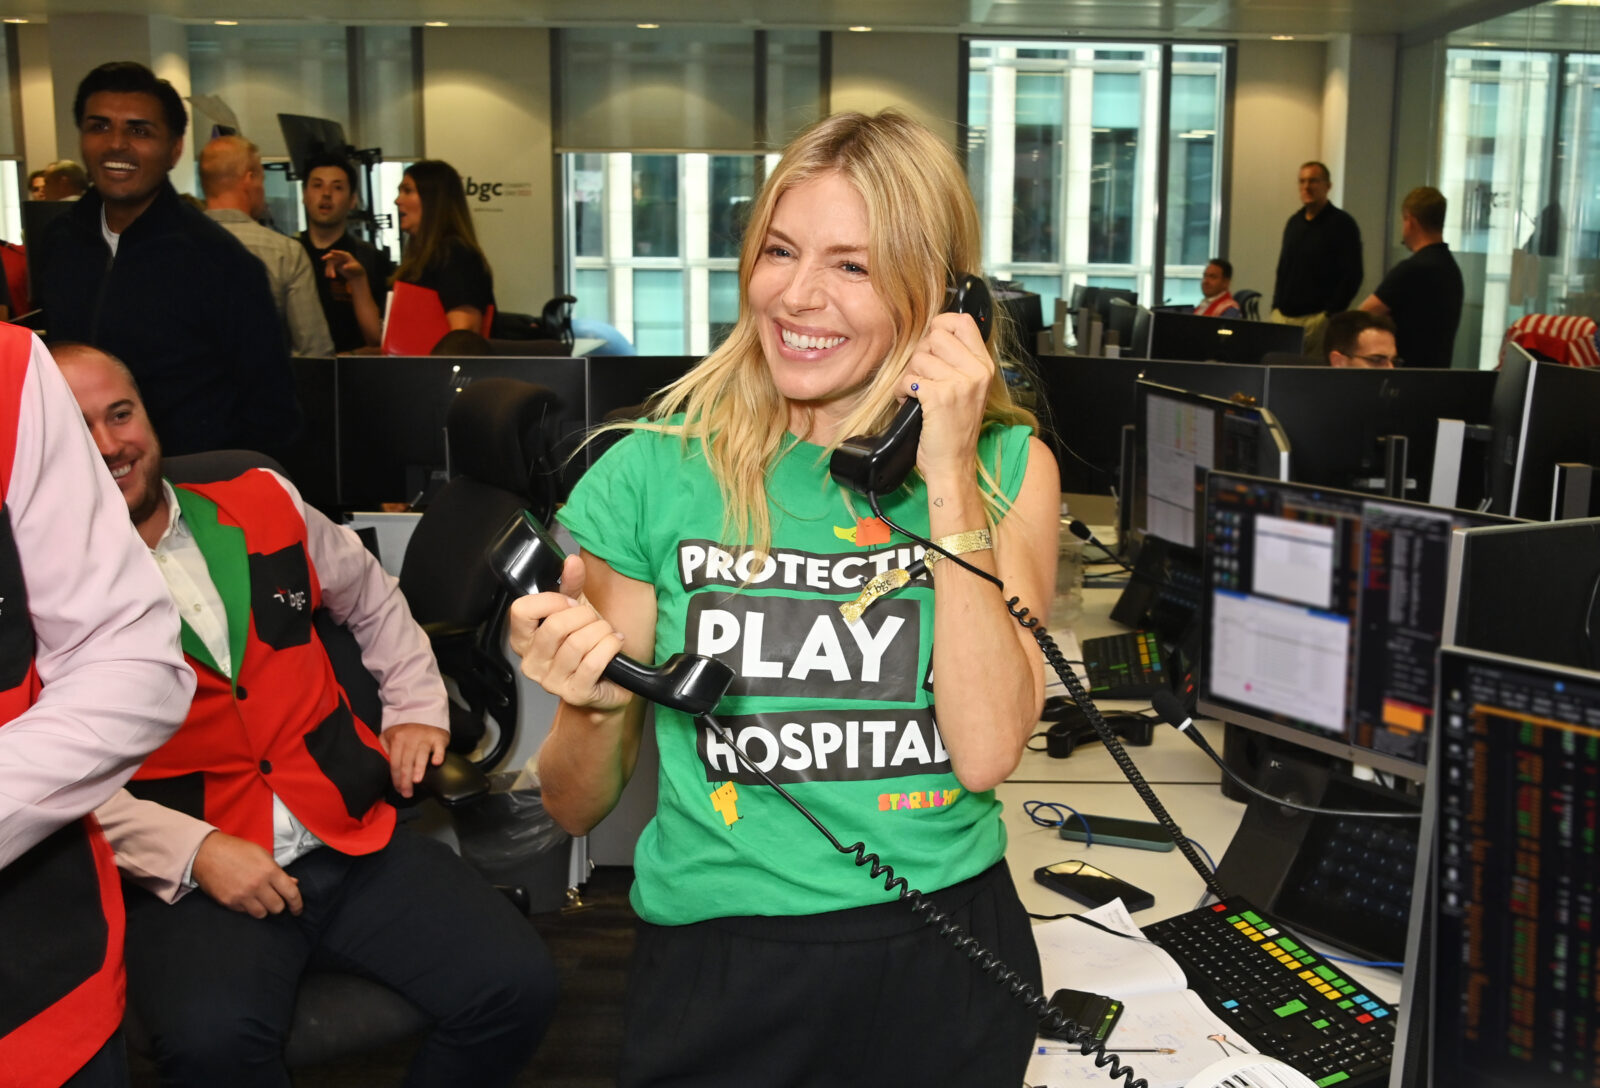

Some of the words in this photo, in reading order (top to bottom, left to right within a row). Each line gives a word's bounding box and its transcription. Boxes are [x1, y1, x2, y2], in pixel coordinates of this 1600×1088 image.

[466, 176, 503, 202] bgc
[288, 589, 306, 610] bgc
[697, 609, 906, 682] PLAY
